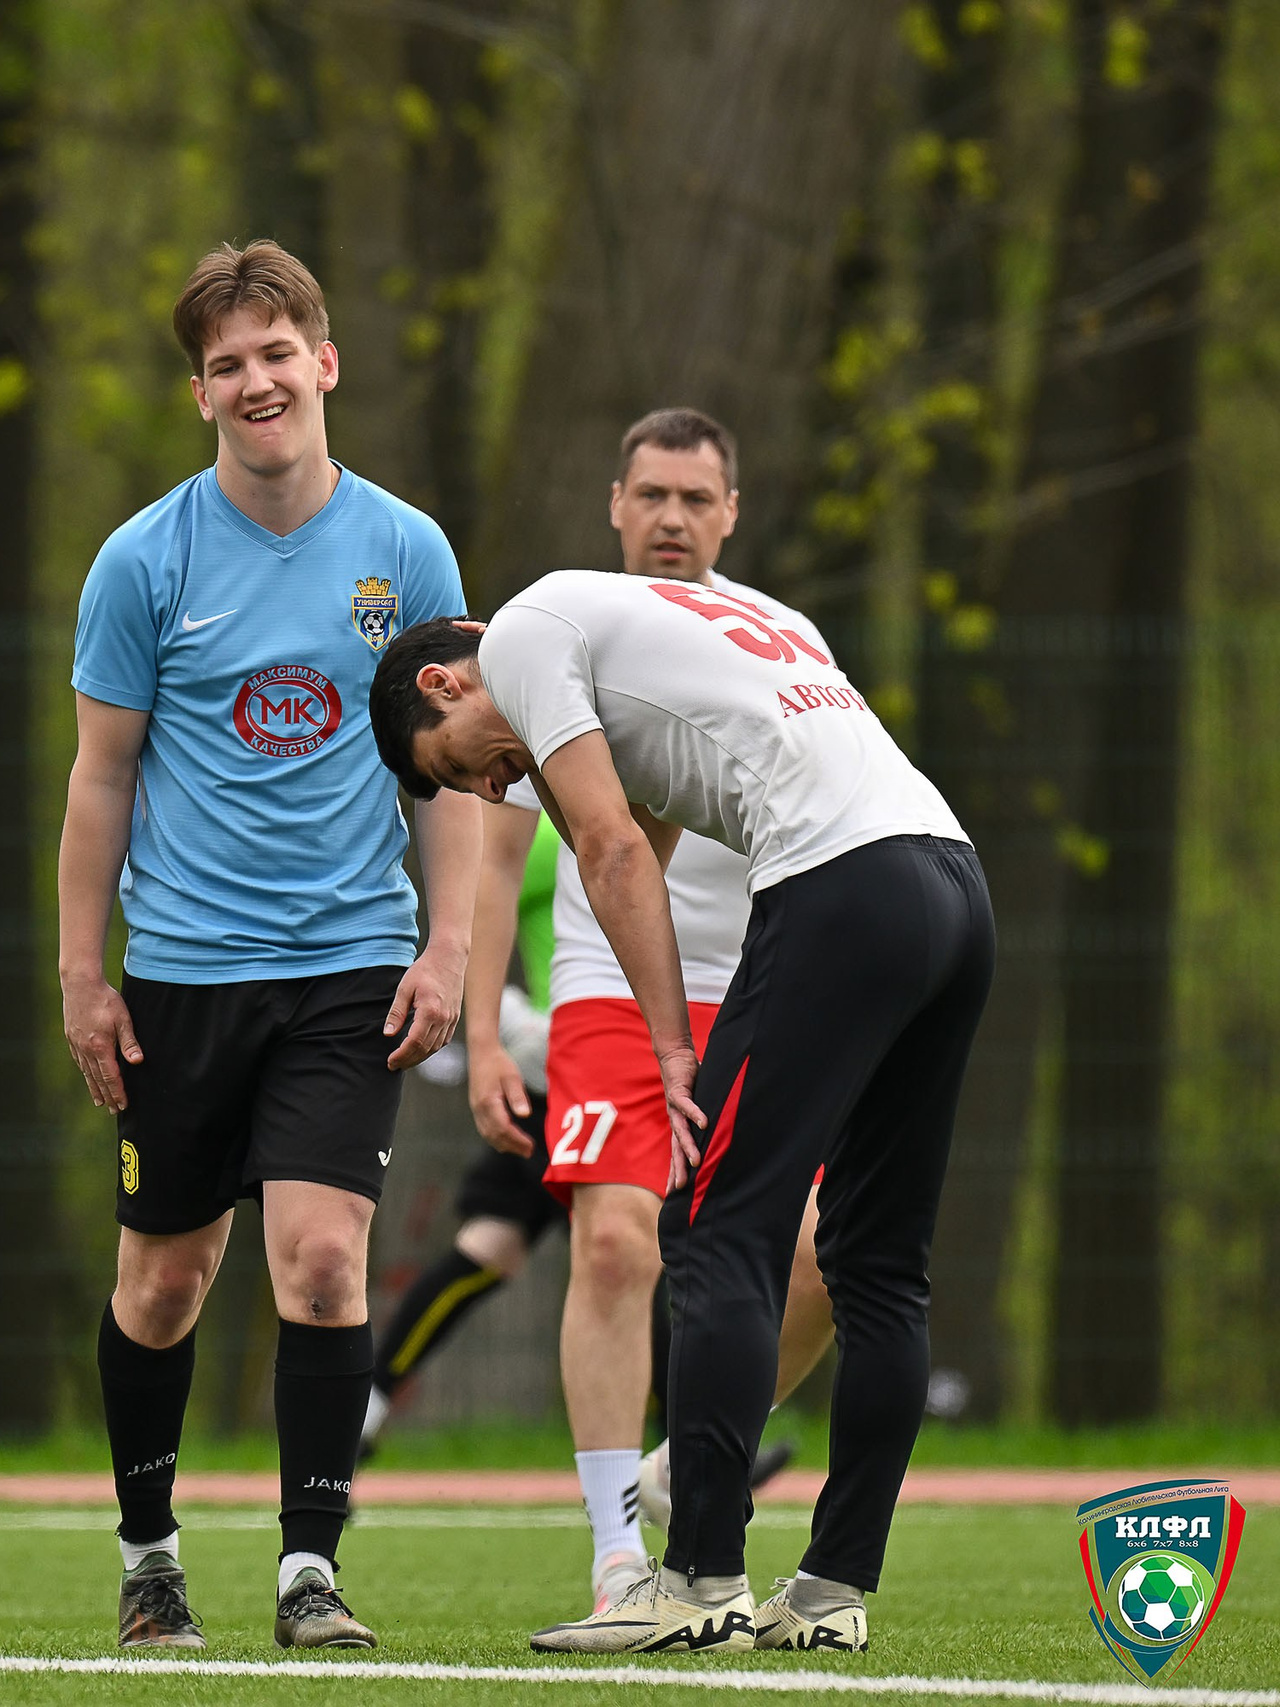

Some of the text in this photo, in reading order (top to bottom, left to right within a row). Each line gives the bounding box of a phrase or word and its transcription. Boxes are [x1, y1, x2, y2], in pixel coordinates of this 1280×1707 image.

[247, 666, 329, 690] МАКСИМУМ
[776, 683, 868, 718] АВТОТ
[250, 735, 324, 756] КАЧЕСТВА
[551, 1101, 618, 1166] 27
[120, 1139, 139, 1195] 3
[127, 1453, 176, 1477] JAKO
[303, 1477, 351, 1494] JAKO
